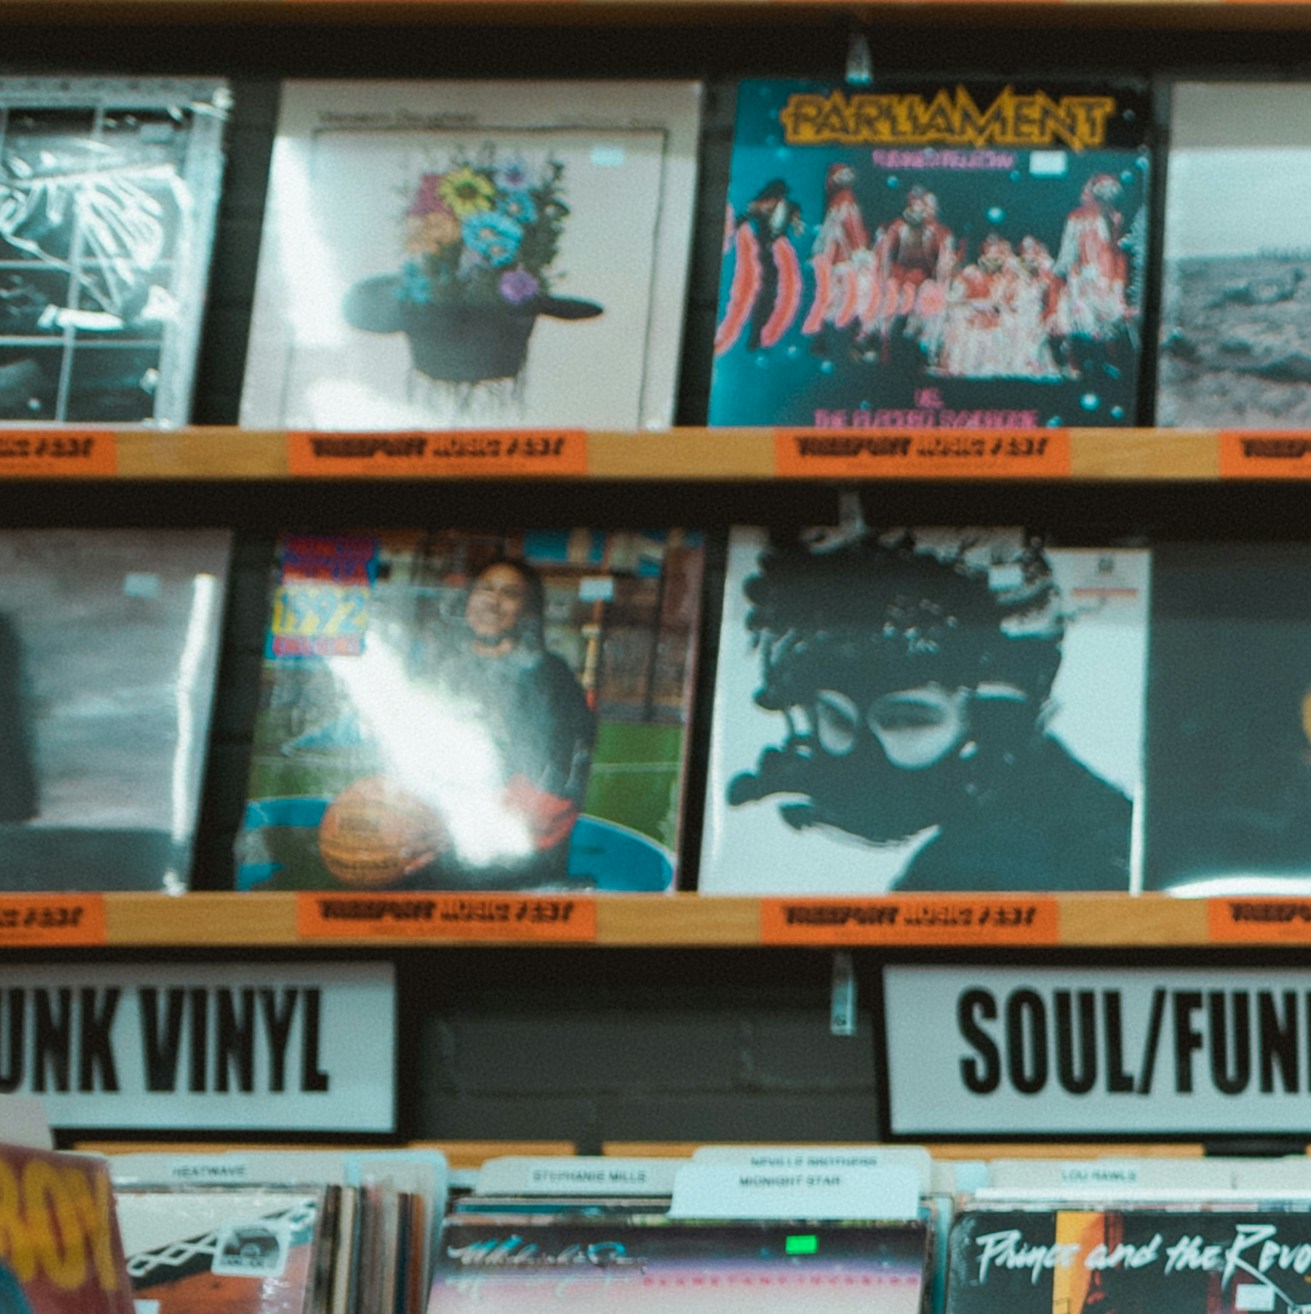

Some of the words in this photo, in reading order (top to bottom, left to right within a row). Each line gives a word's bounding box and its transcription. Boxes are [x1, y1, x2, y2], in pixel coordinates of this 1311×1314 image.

[780, 84, 1115, 153] PARLIAMENT
[138, 986, 330, 1093] VINYL
[171, 1165, 247, 1178] HEATWAVE
[533, 1169, 607, 1184] STEPHANIE
[611, 1169, 647, 1184] MILLS
[739, 1174, 803, 1188] MIDNIGHT
[806, 1174, 842, 1188] STAR
[1084, 1232, 1162, 1270] and
[1165, 1235, 1226, 1276] the
